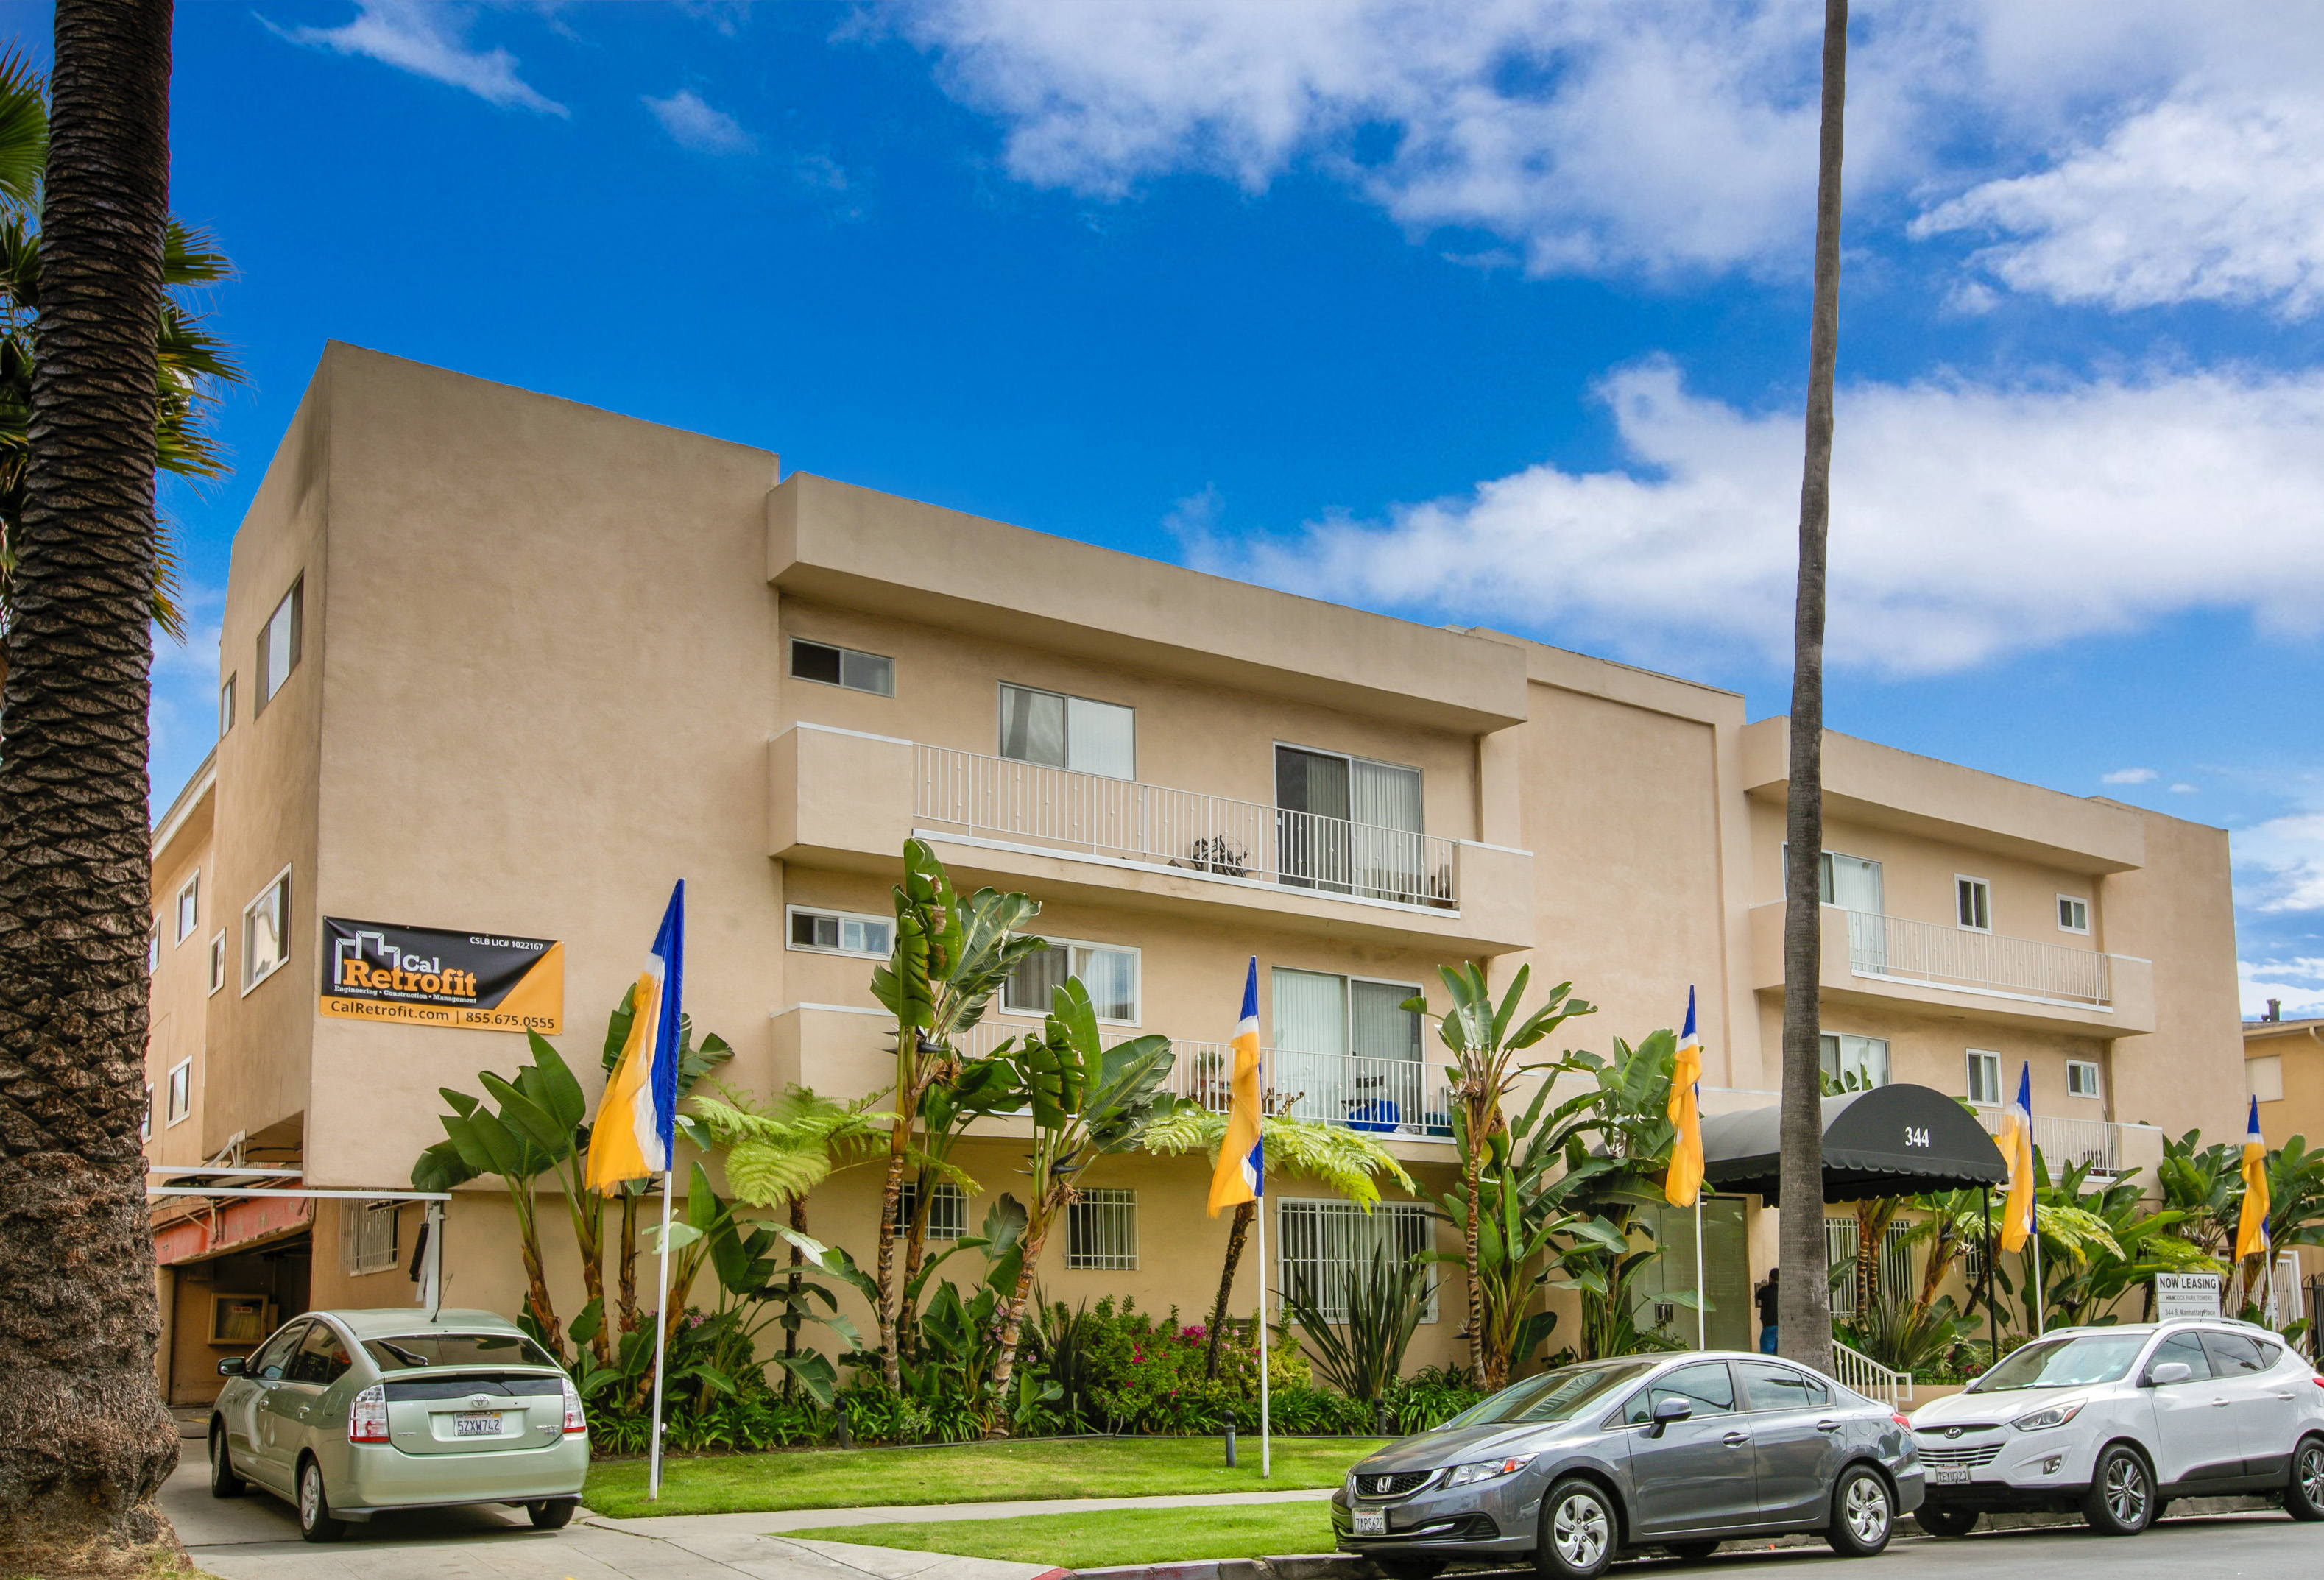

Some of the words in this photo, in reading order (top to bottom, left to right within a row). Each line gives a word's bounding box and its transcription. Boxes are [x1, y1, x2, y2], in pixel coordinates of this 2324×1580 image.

[470, 937, 490, 946] CSLB
[492, 938, 509, 947] LIC#
[512, 941, 543, 950] 1022167
[402, 954, 441, 974] Cal
[342, 959, 476, 996] Retrofit
[334, 985, 378, 996] Engineering
[383, 990, 428, 999] Construction
[433, 994, 476, 1004] Management
[331, 1001, 449, 1021] CalRetrofit.com
[466, 1012, 554, 1029] 855.675.0555
[1905, 1127, 1930, 1147] 344
[2160, 1278, 2179, 1289] NOW
[2181, 1278, 2217, 1289] LEASING
[458, 1420, 500, 1432] 5ZXW742
[1938, 1470, 1967, 1482] 7EYU323
[1355, 1517, 1383, 1530] 7APS622
